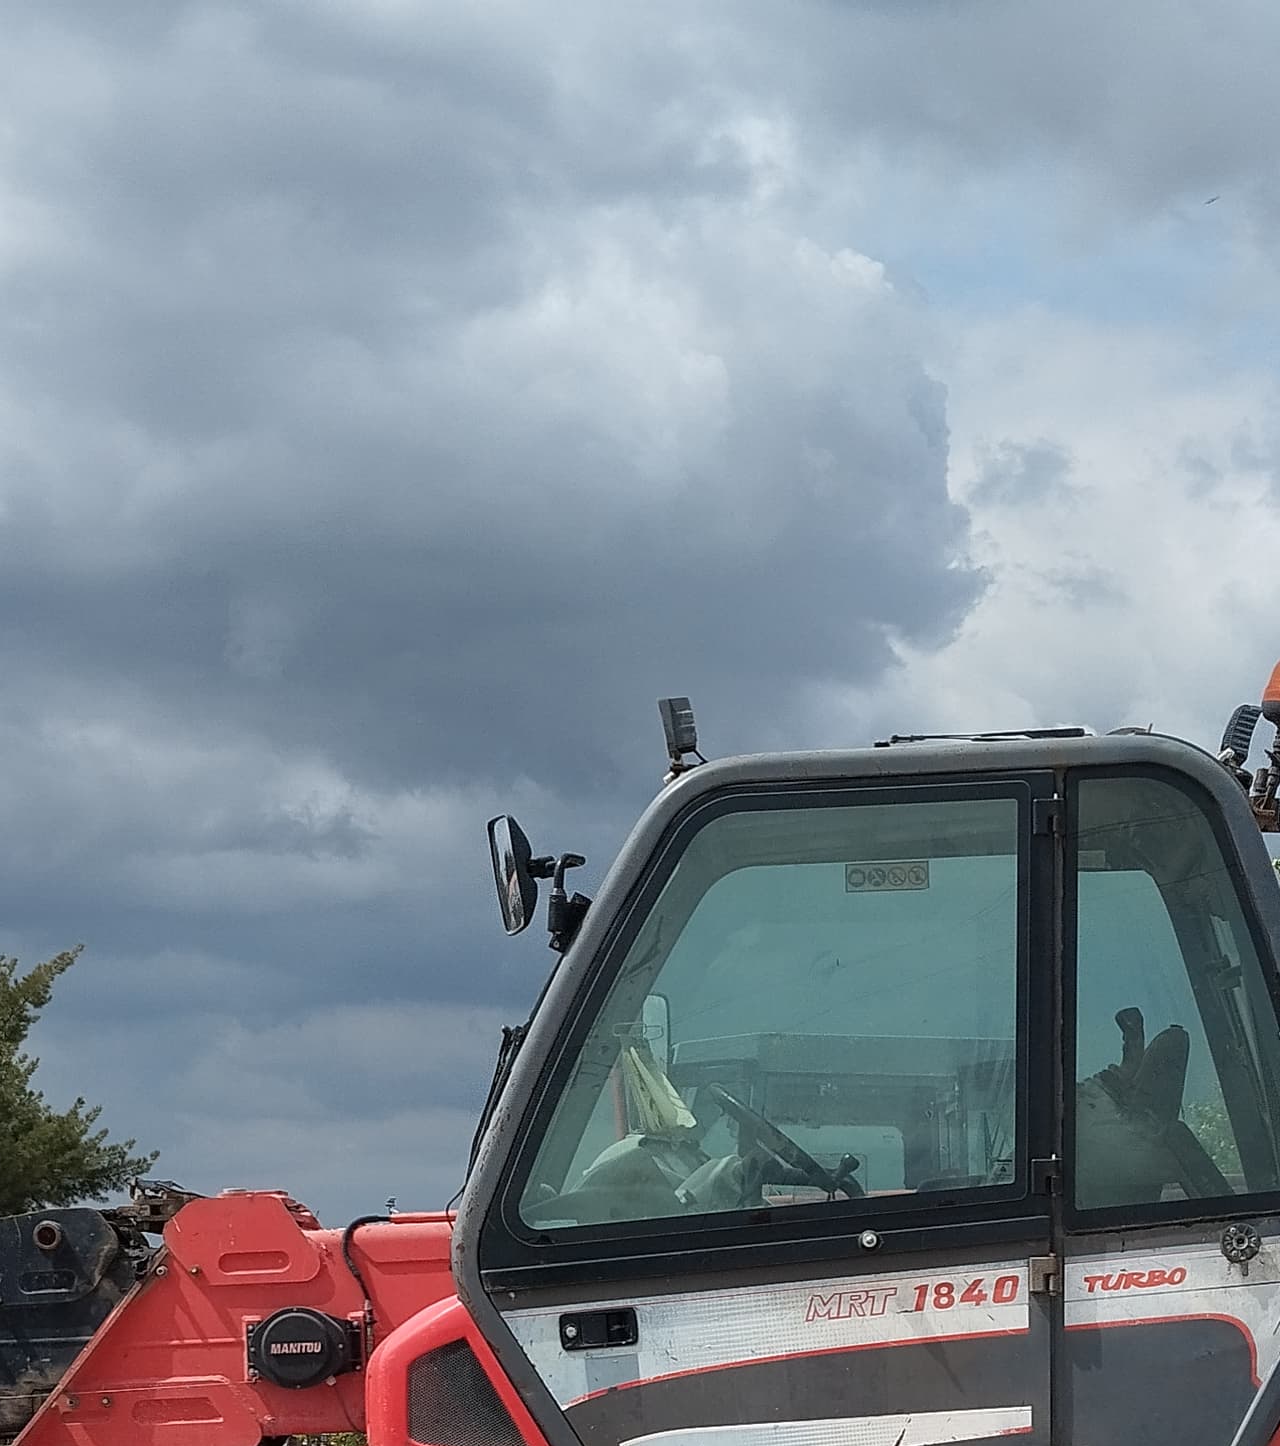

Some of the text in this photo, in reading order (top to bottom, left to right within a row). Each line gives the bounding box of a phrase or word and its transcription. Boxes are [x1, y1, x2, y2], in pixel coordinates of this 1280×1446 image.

[1083, 1267, 1187, 1293] TURBO
[805, 1275, 1020, 1323] MRT 1840
[271, 1341, 322, 1354] MANITOU
